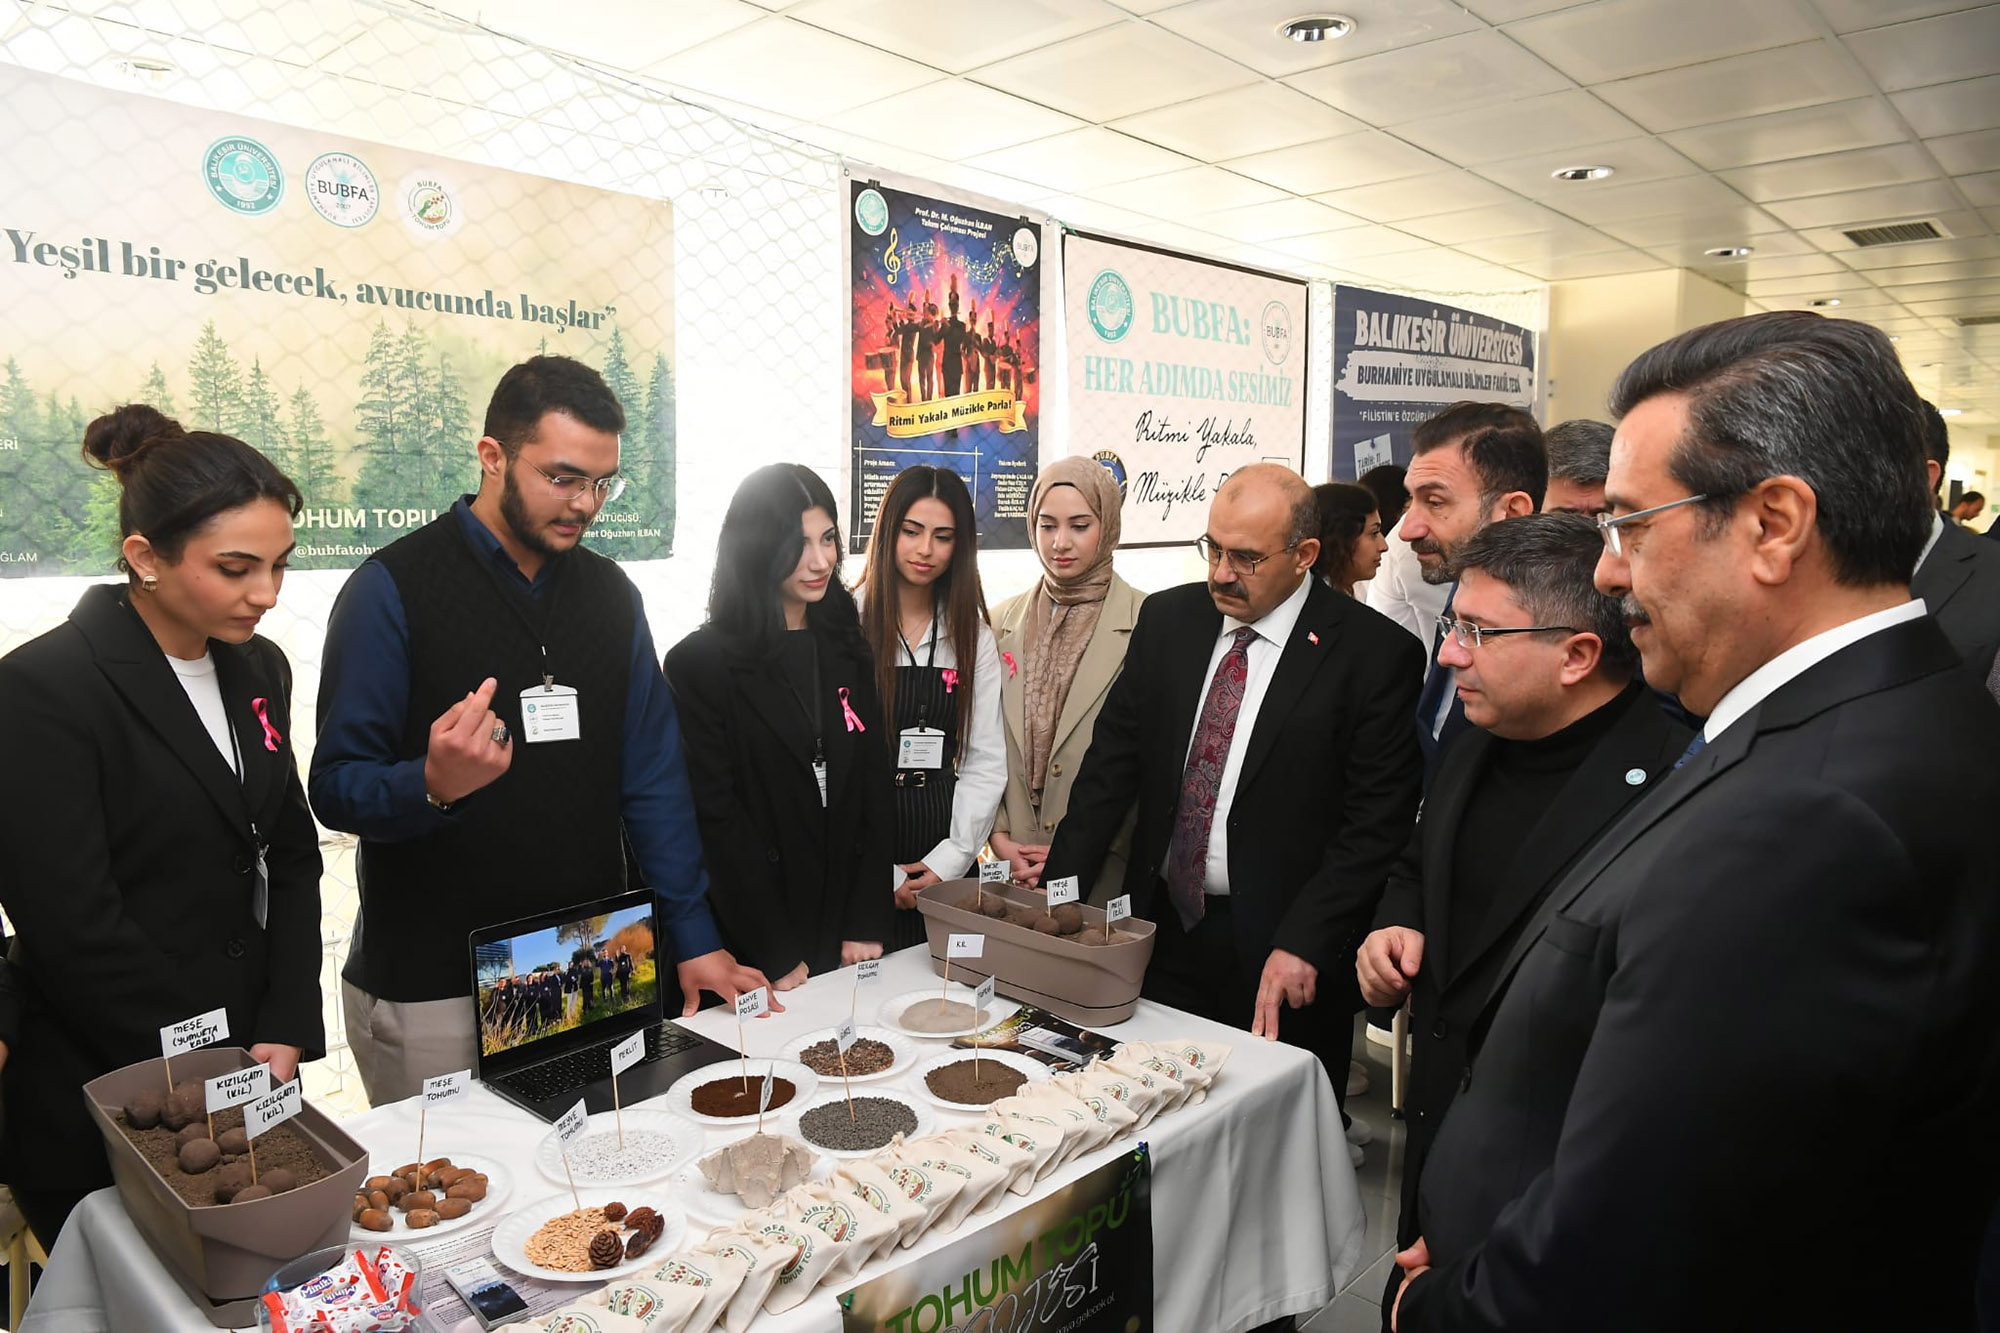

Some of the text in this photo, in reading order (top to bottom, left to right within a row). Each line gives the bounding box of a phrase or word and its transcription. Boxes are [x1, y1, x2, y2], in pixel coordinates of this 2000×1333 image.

[317, 179, 370, 201] BUBFA
[2, 228, 112, 280] Yeşil
[119, 240, 186, 281] bir
[194, 257, 348, 307] gelecek,
[356, 282, 514, 320] avucunda
[1151, 291, 1250, 346] BUBFA:
[1355, 309, 1524, 366] BALIKESİR ÜNİVERSİTESİ
[1084, 355, 1292, 407] HER ADIMDA SESİMİZ
[1357, 362, 1413, 386] BURHANİYE
[1415, 367, 1464, 390] UYGULAMALI
[1464, 368, 1492, 391] BİLİMLER
[889, 399, 1012, 427] Ritmi Yakala Müzikle Parla!
[1136, 410, 1258, 463] Ritmi Yakala,
[1133, 471, 1207, 521] Müzikle
[292, 508, 366, 528] OHUM
[600, 528, 635, 539] Oğuzhan
[637, 527, 660, 537] İLBAN
[738, 992, 758, 1008] KAHVE
[739, 1003, 760, 1017] POSASI
[173, 1017, 204, 1035] MEŞE
[618, 1041, 639, 1062] PERLİT
[226, 1083, 252, 1100] (KİL)
[427, 1086, 460, 1101] TOHUMU
[430, 1077, 454, 1089] MEŞE
[262, 1104, 285, 1123] (KİL)
[779, 1264, 805, 1286] TOHUM
